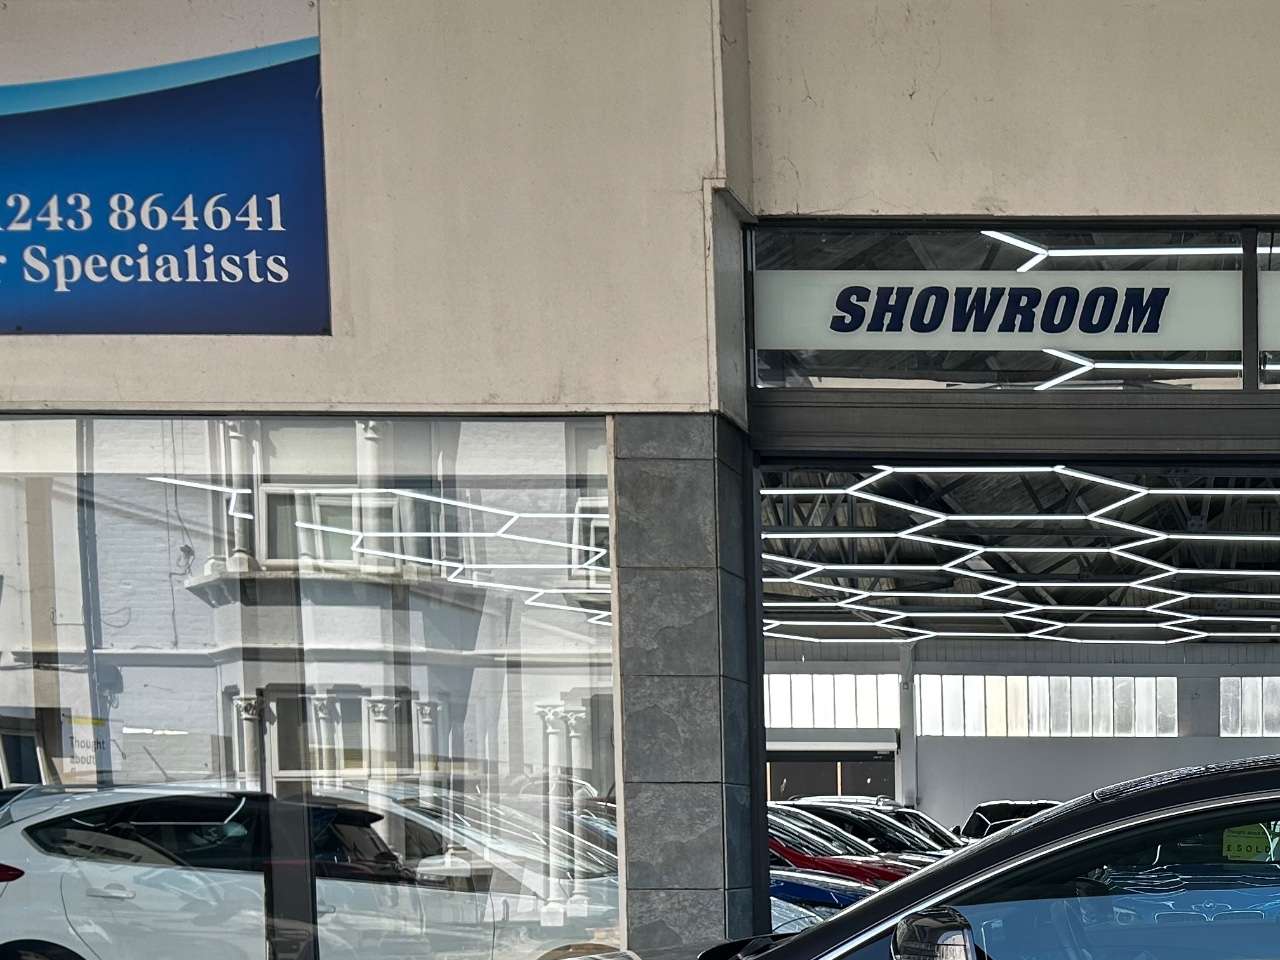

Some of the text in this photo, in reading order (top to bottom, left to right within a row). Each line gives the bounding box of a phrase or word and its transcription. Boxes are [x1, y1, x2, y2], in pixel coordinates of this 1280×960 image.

[0, 193, 287, 232] 243 864641
[22, 243, 290, 292] Specialists
[829, 285, 1171, 334] SHOWROOM
[70, 736, 105, 750] Thought
